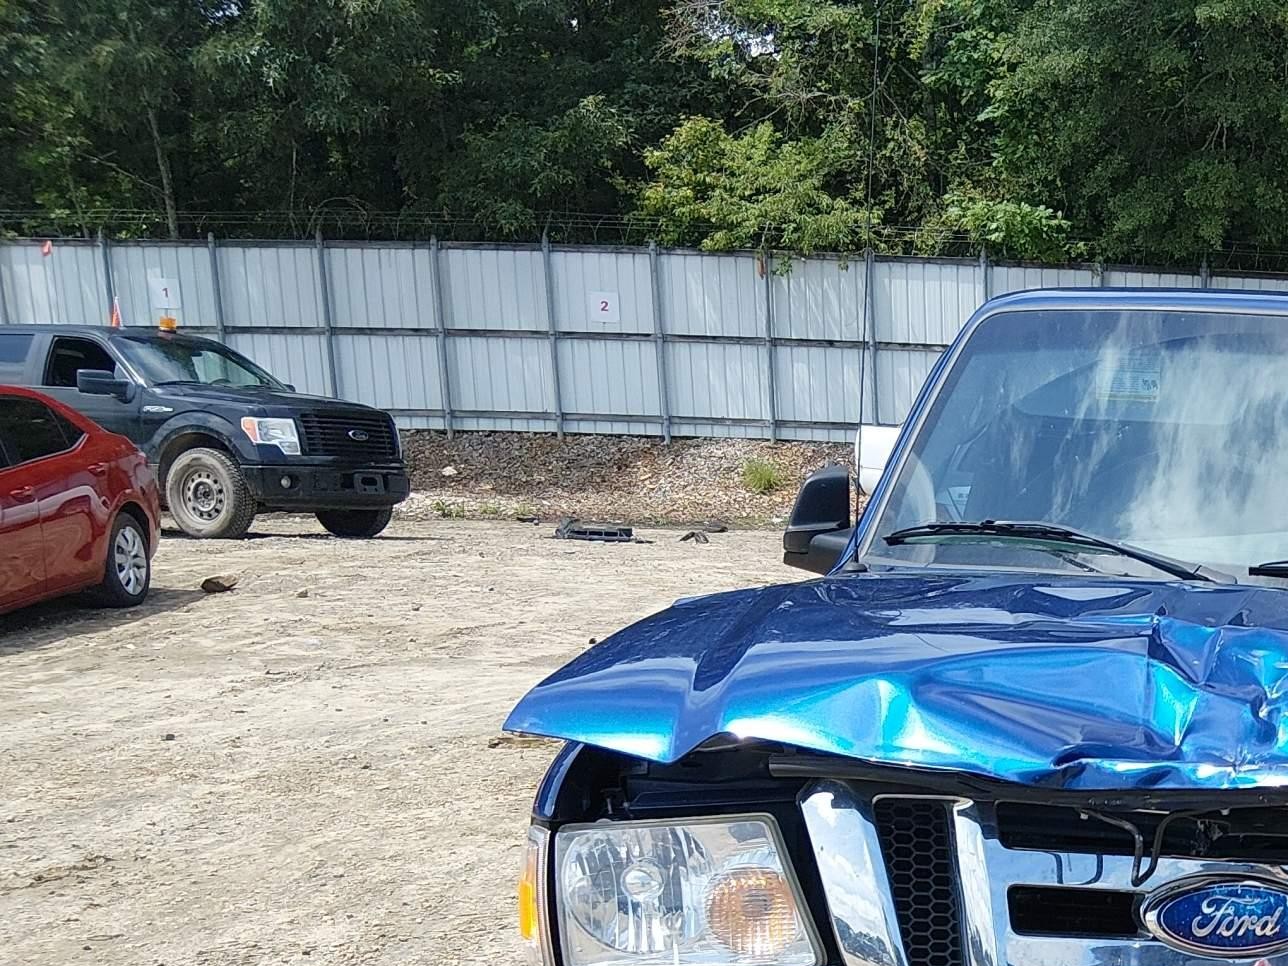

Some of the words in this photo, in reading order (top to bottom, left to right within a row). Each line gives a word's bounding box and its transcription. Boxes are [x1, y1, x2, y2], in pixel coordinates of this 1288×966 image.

[162, 288, 169, 297] 1
[600, 301, 609, 312] 2
[1192, 895, 1282, 937] Ford
